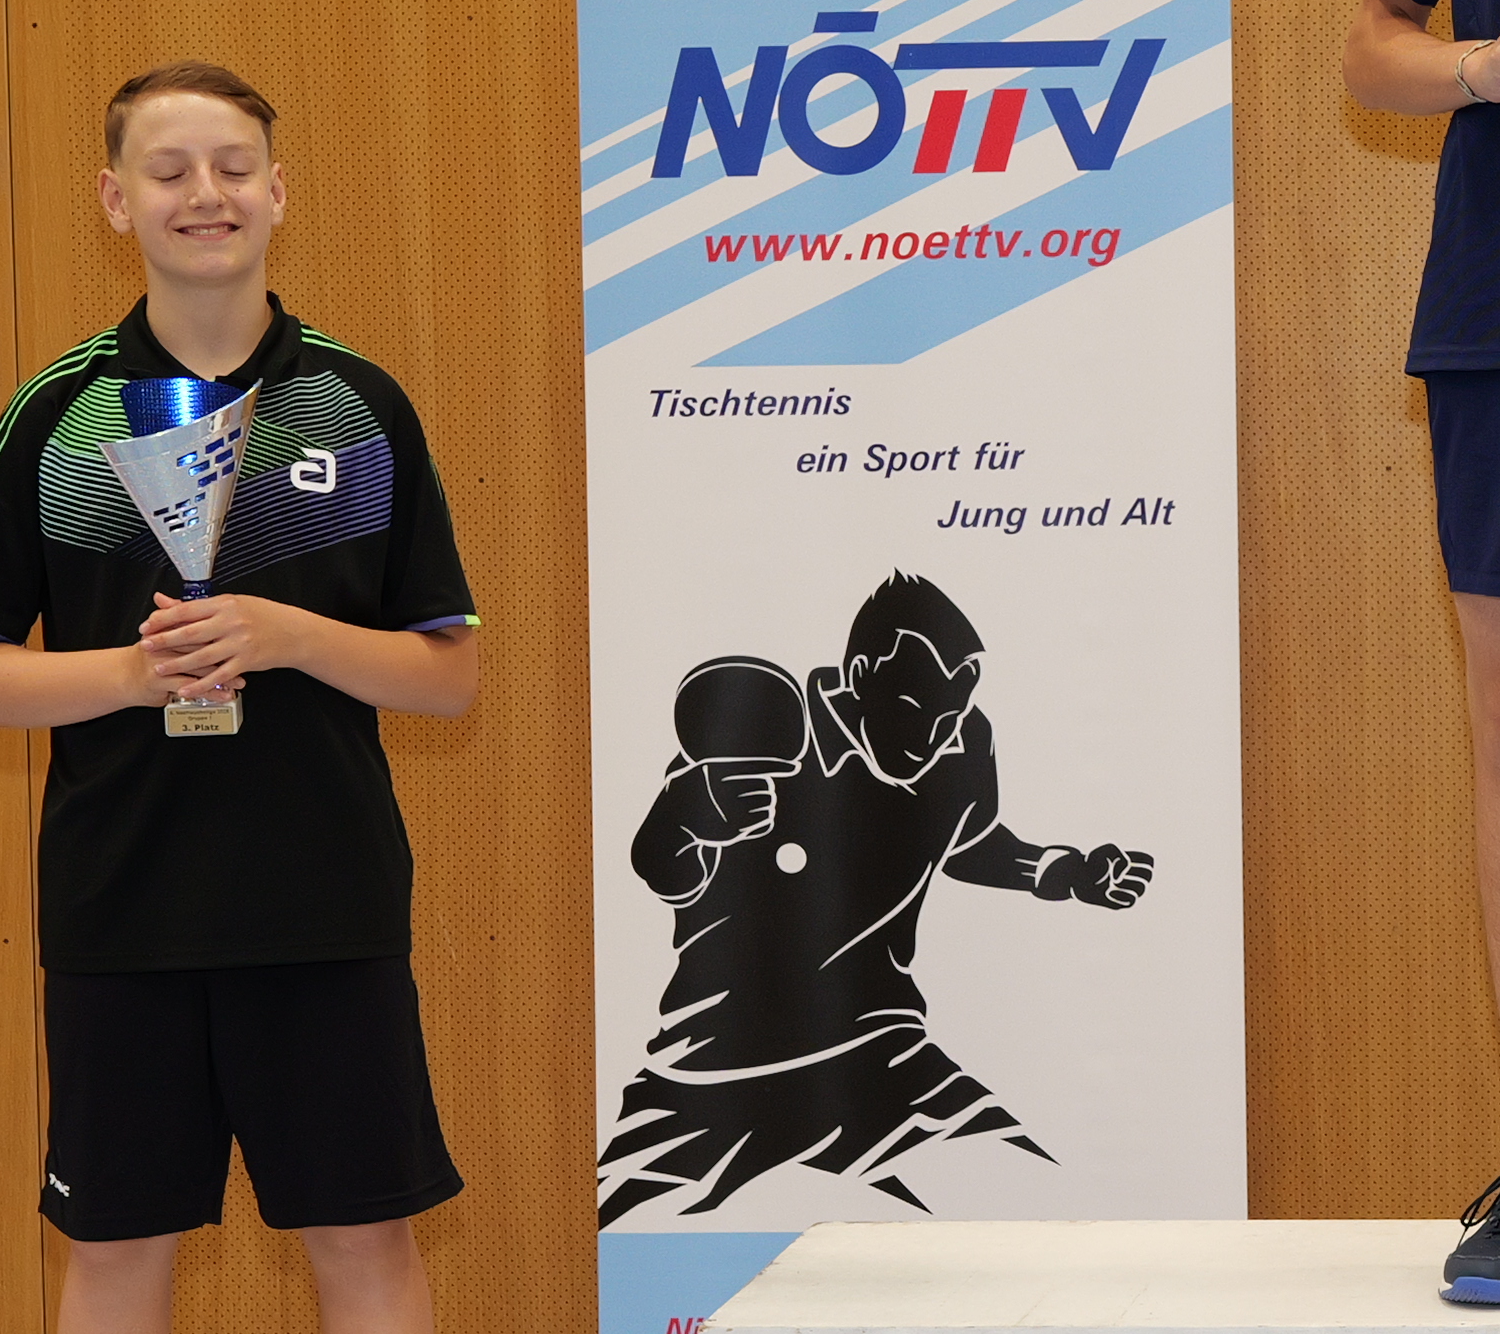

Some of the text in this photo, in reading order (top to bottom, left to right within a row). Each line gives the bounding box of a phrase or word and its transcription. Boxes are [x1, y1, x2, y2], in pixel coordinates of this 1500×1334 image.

[703, 223, 1122, 268] www.noettv.org
[647, 387, 853, 418] Tischtennis
[795, 441, 1026, 479] ein Sport für
[936, 496, 1176, 535] Jung und Alt
[195, 723, 220, 731] Platz
